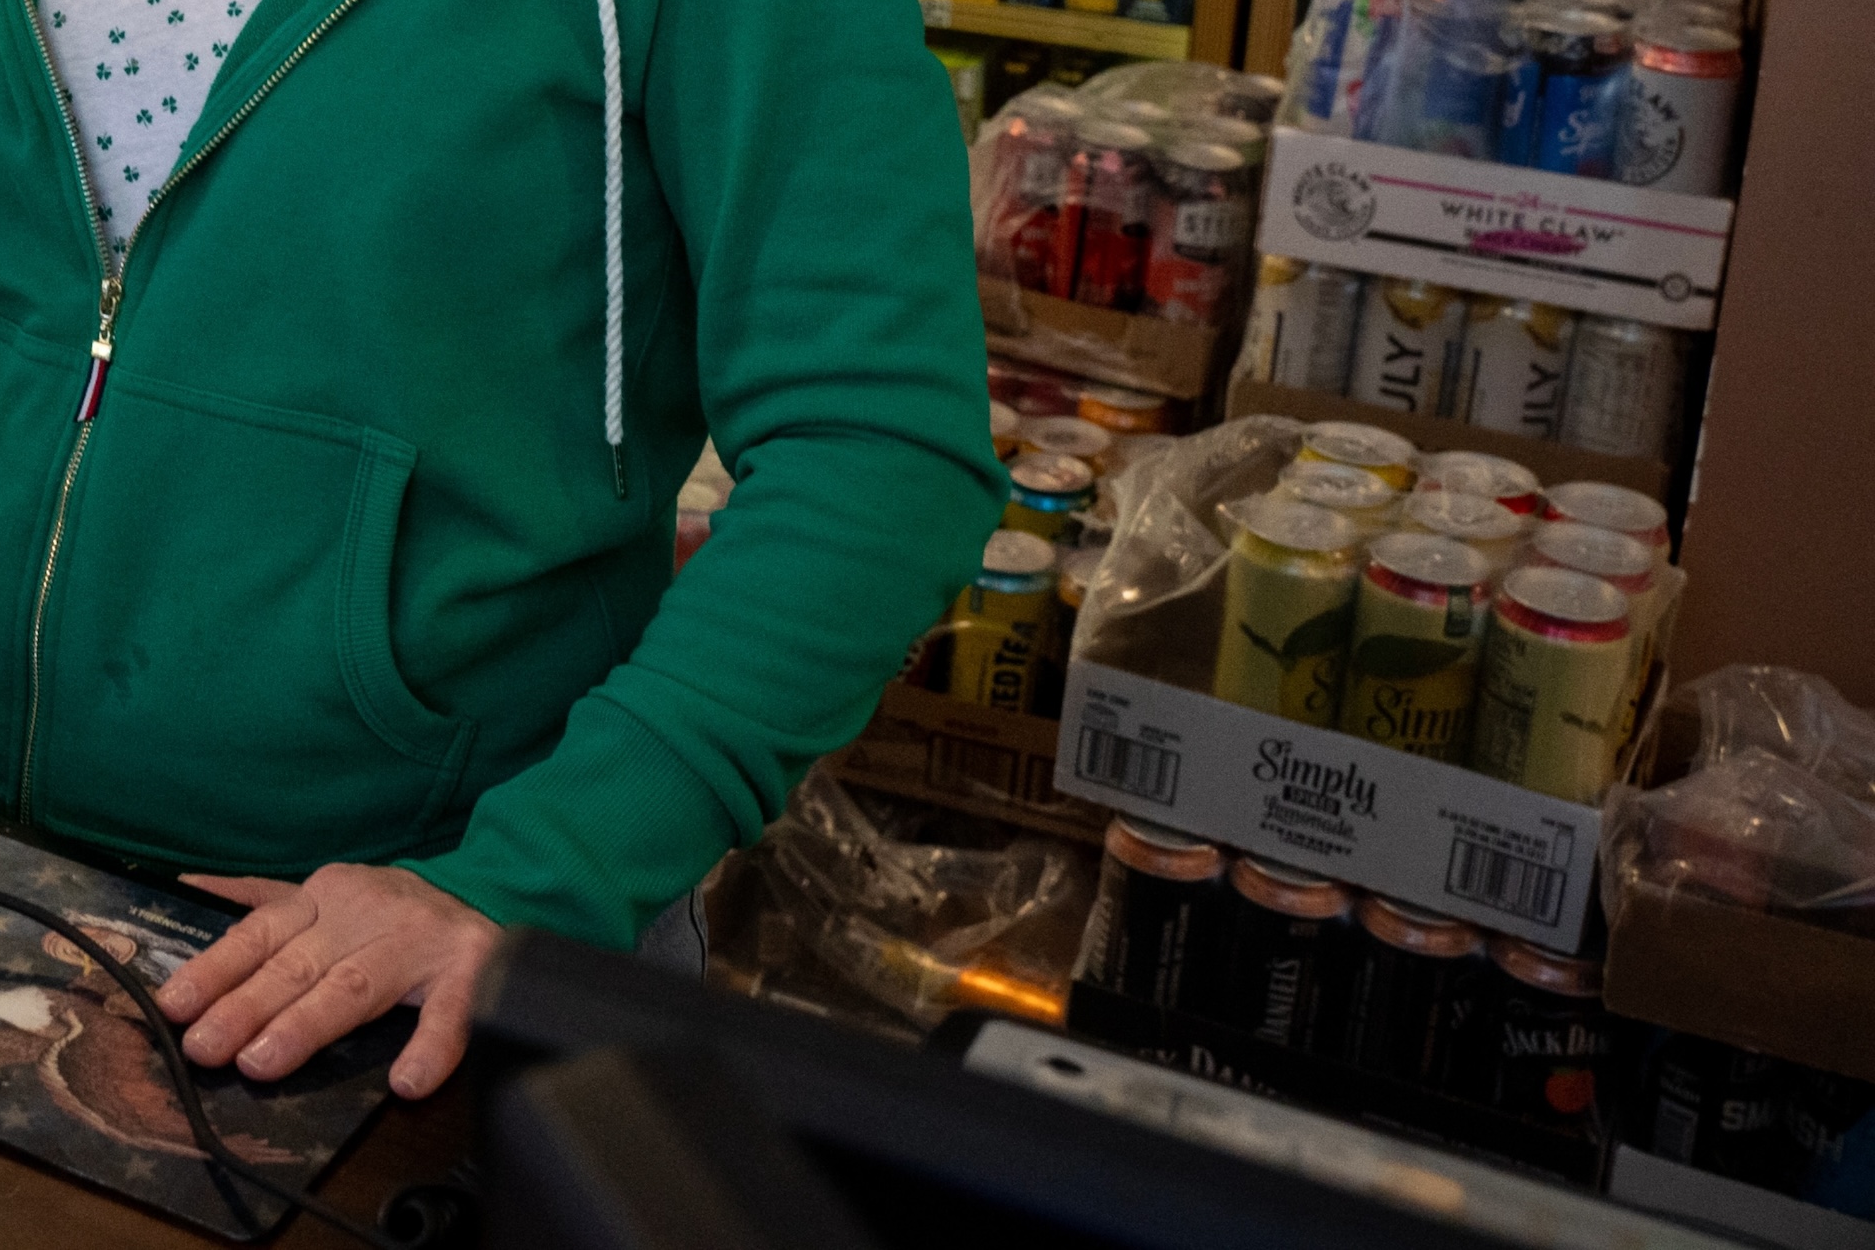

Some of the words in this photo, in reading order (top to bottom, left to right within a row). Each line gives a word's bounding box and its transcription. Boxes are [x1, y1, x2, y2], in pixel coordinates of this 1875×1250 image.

[1439, 197, 1527, 232] WHITE
[1538, 209, 1615, 244] CLAW
[1252, 736, 1381, 818] Simply
